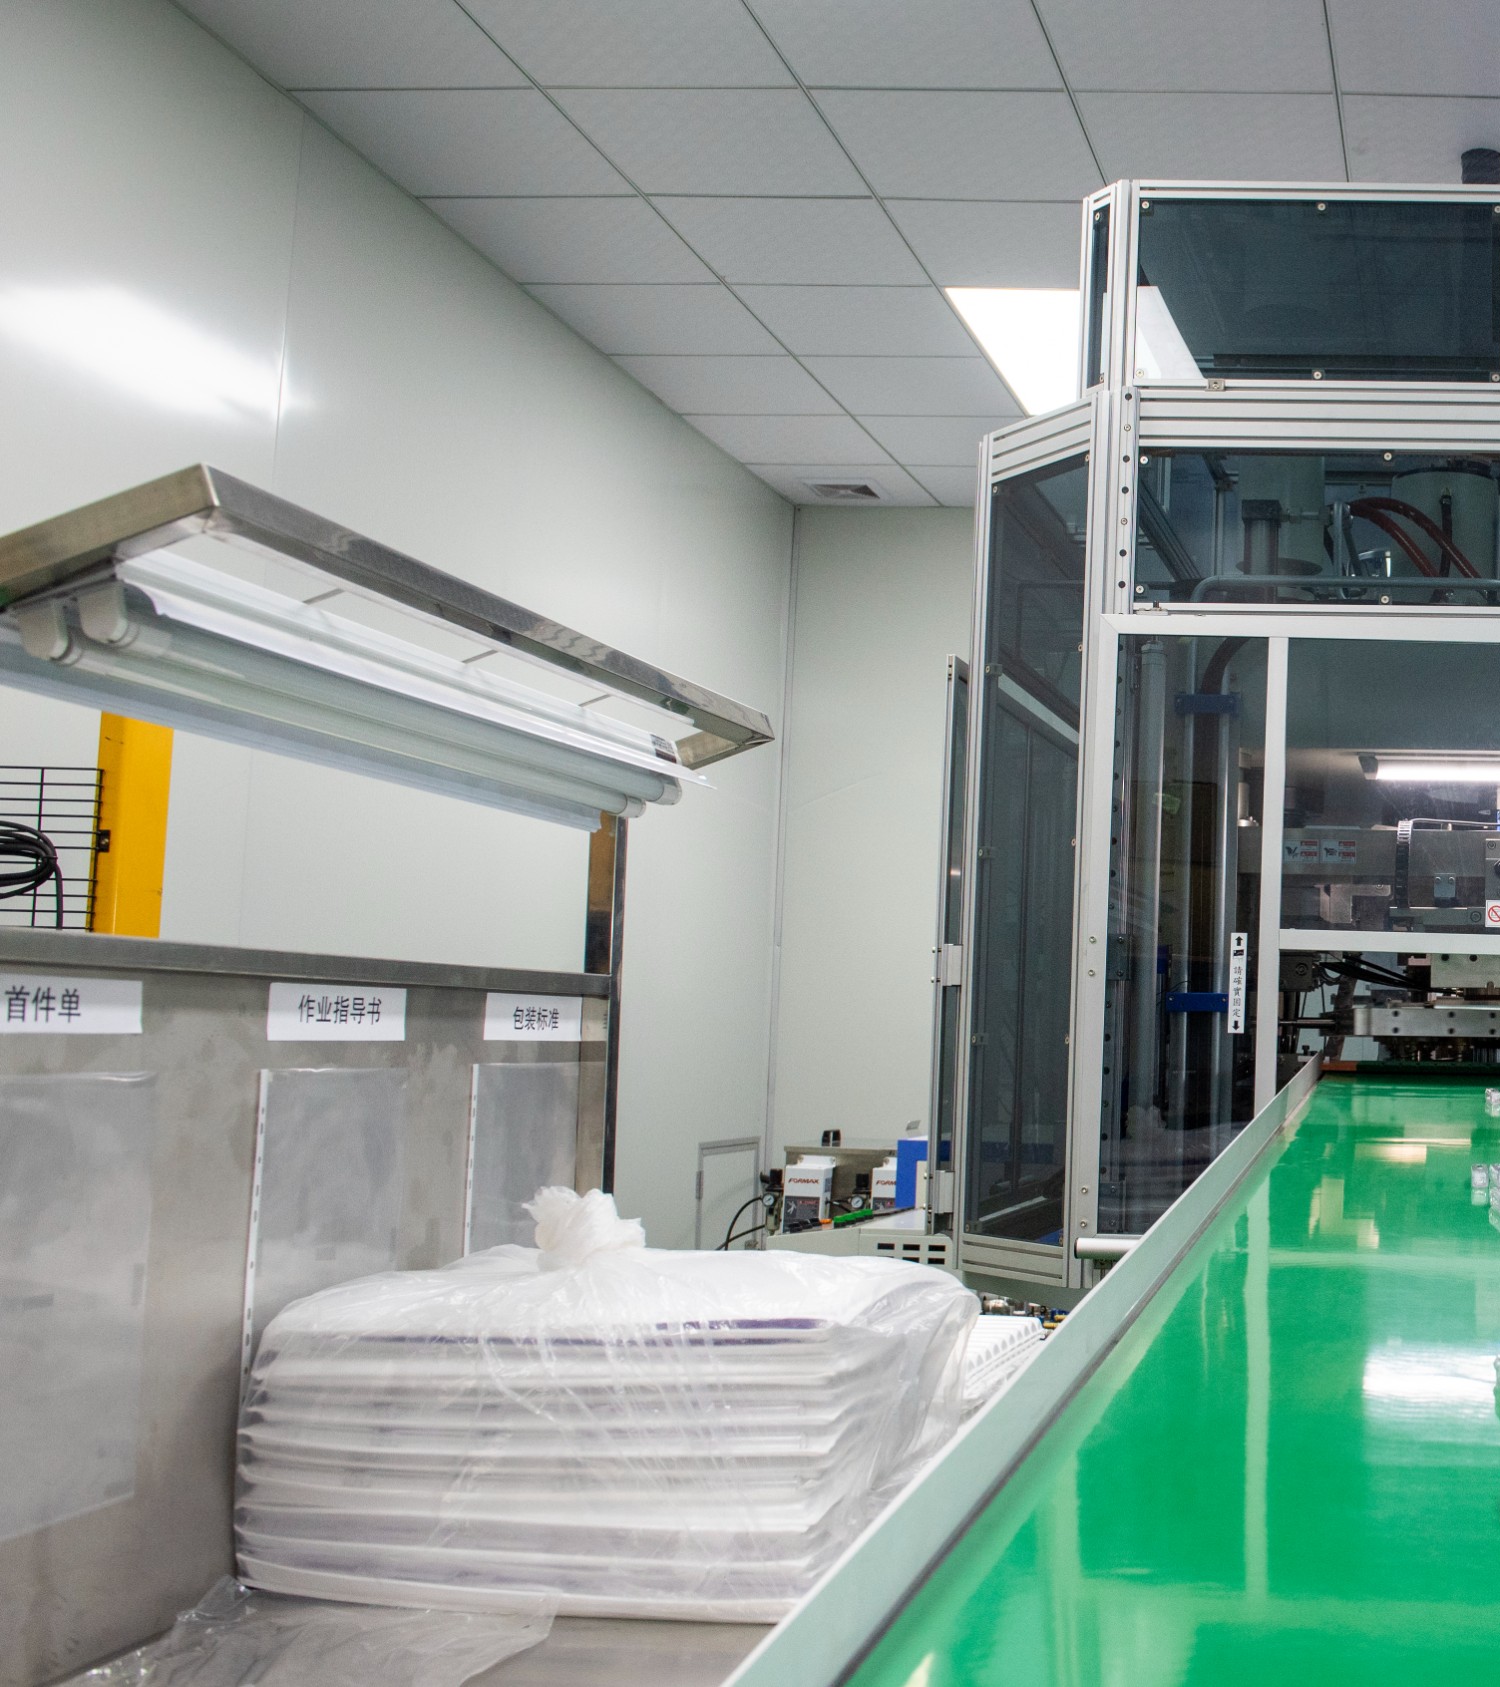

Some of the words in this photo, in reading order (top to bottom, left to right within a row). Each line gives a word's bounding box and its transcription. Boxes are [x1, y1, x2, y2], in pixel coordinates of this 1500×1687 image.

[4, 985, 81, 1023] 首件单
[298, 994, 382, 1025] 作业指导书
[513, 1006, 560, 1031] 包装标准
